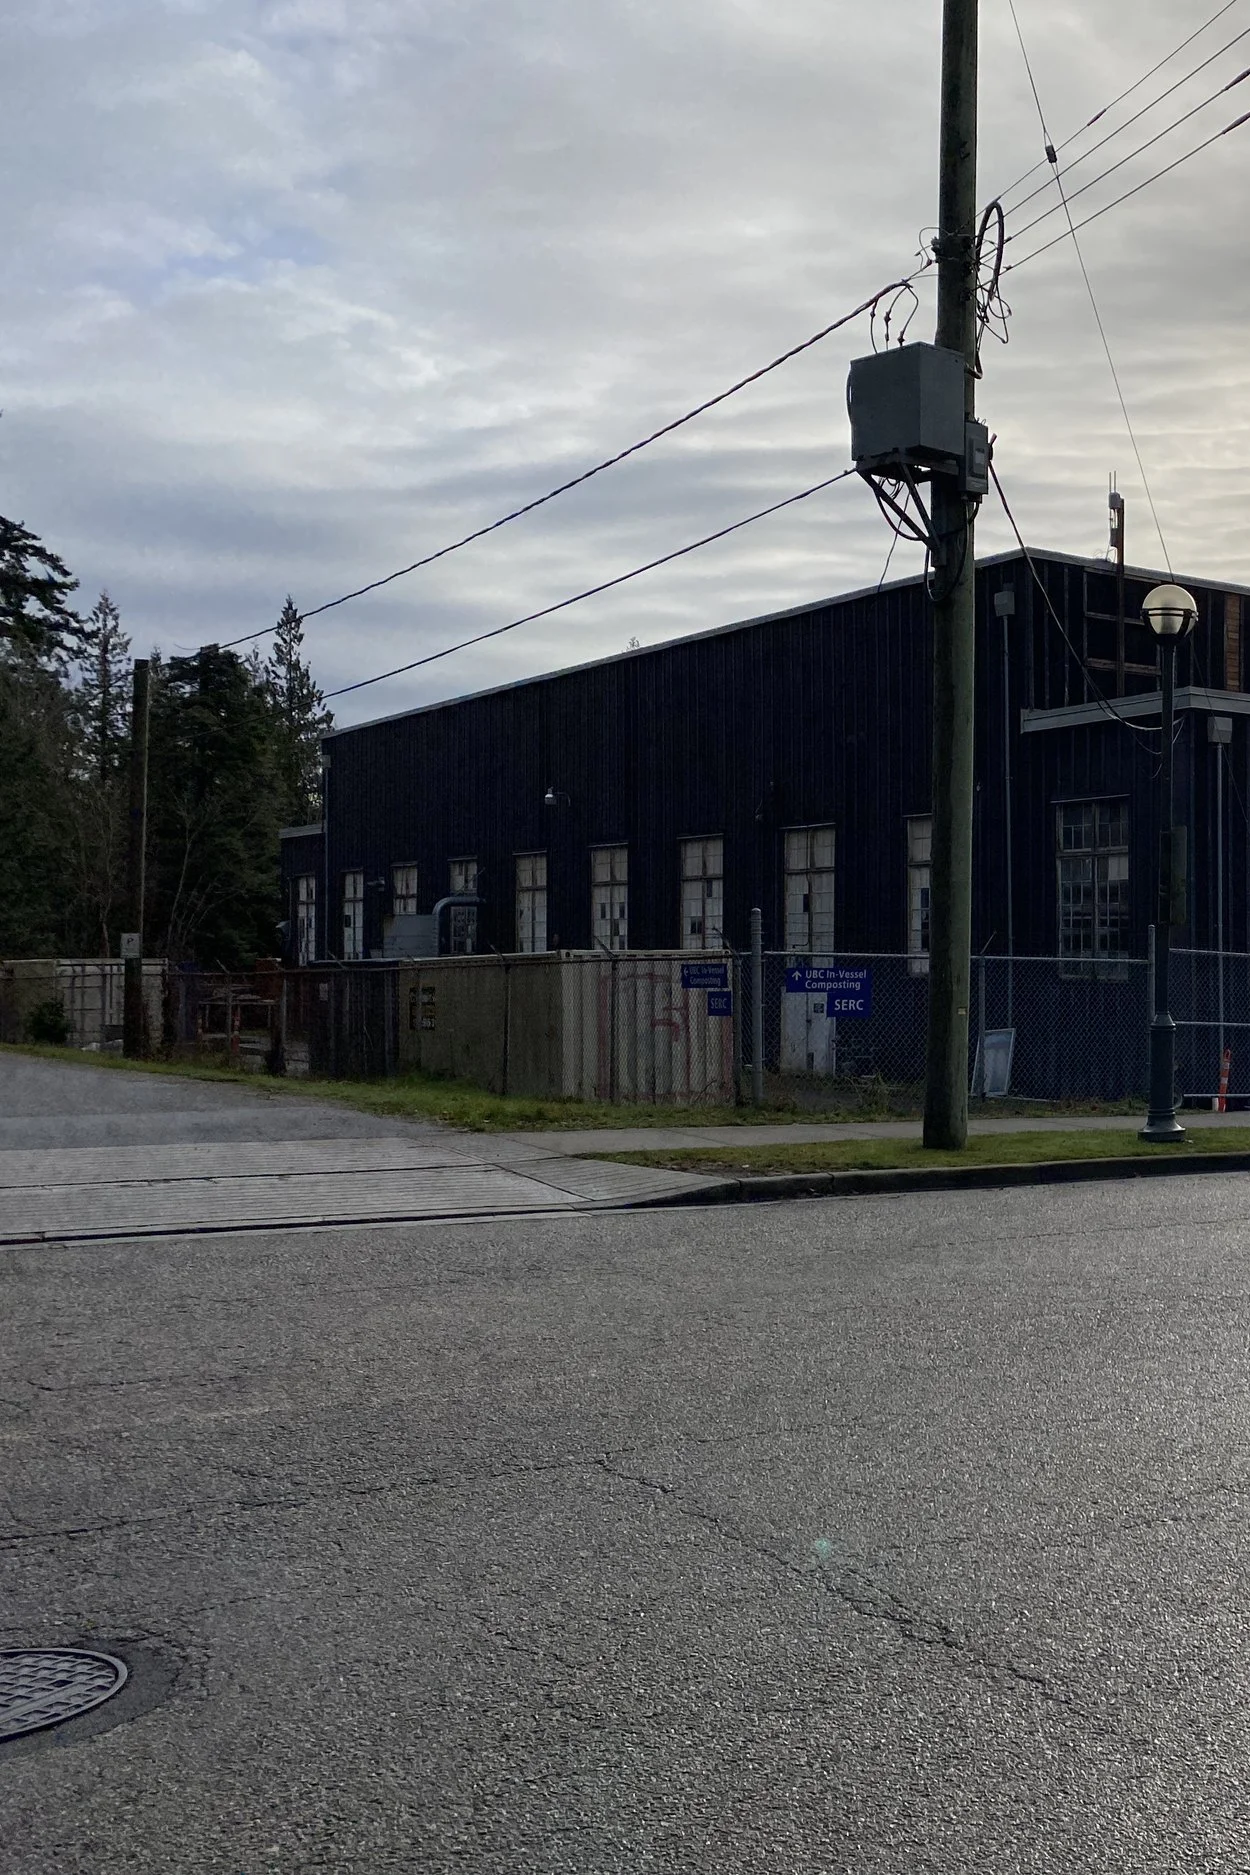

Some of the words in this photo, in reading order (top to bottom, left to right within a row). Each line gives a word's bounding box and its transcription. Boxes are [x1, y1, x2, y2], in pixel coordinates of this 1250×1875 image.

[805, 969, 825, 979] UBC
[826, 969, 867, 979] In-Vessel
[805, 979, 861, 991] Composting
[710, 997, 728, 1009] SERC
[834, 999, 864, 1011] SERC
